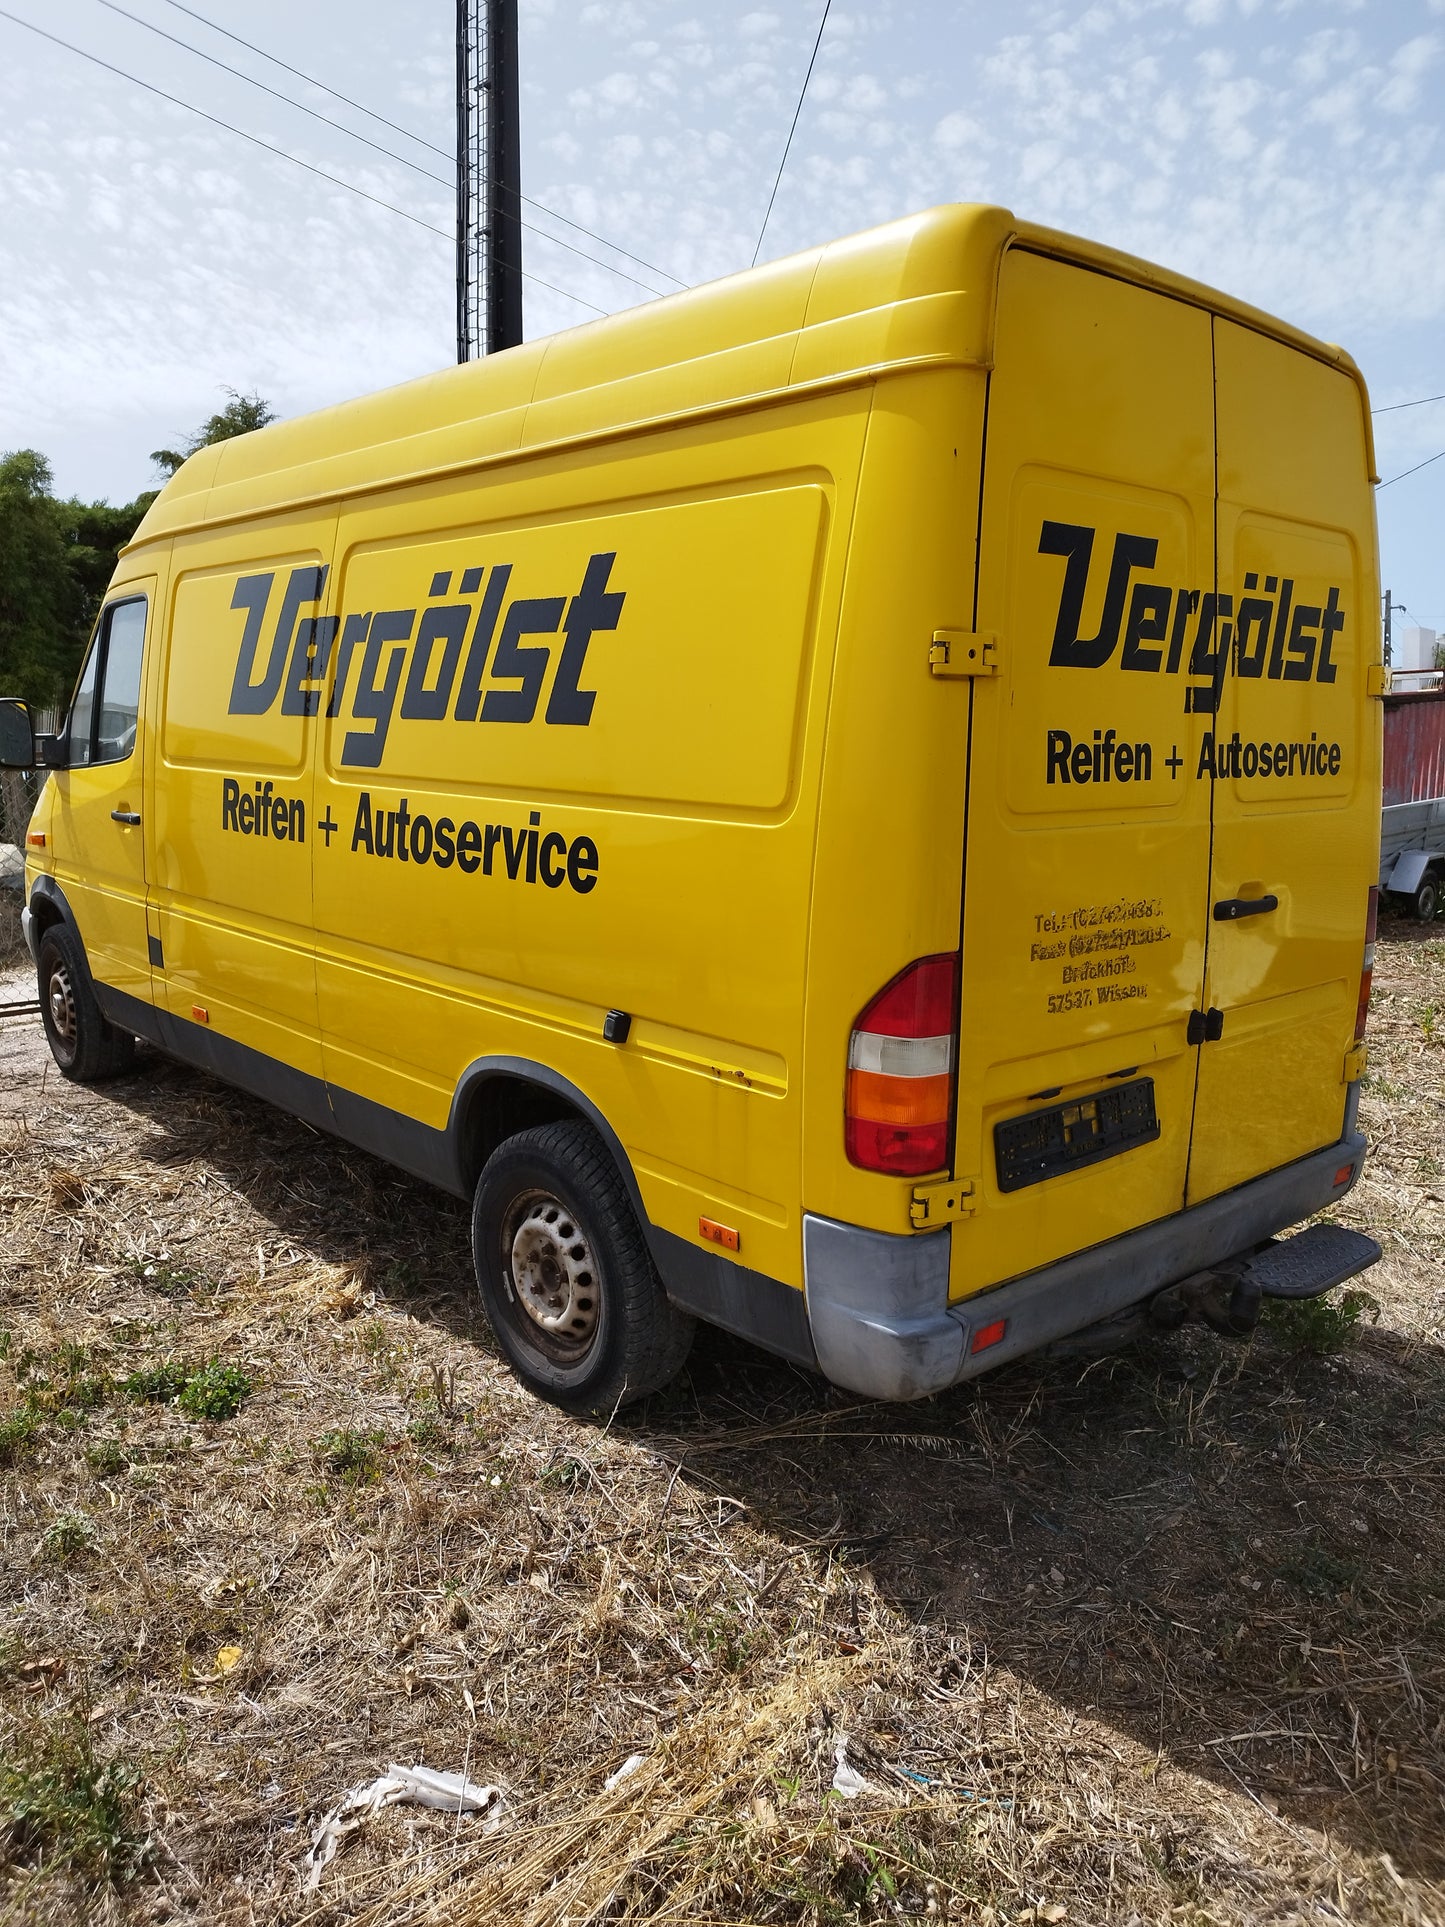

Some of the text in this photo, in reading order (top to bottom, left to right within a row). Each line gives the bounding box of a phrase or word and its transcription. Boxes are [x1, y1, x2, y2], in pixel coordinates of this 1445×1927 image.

[228, 552, 626, 767] Vergölst
[1038, 520, 1345, 714] Vergölst
[1046, 729, 1340, 784] Reifen + Autoservice
[222, 778, 599, 894] Reifen + Autoservice
